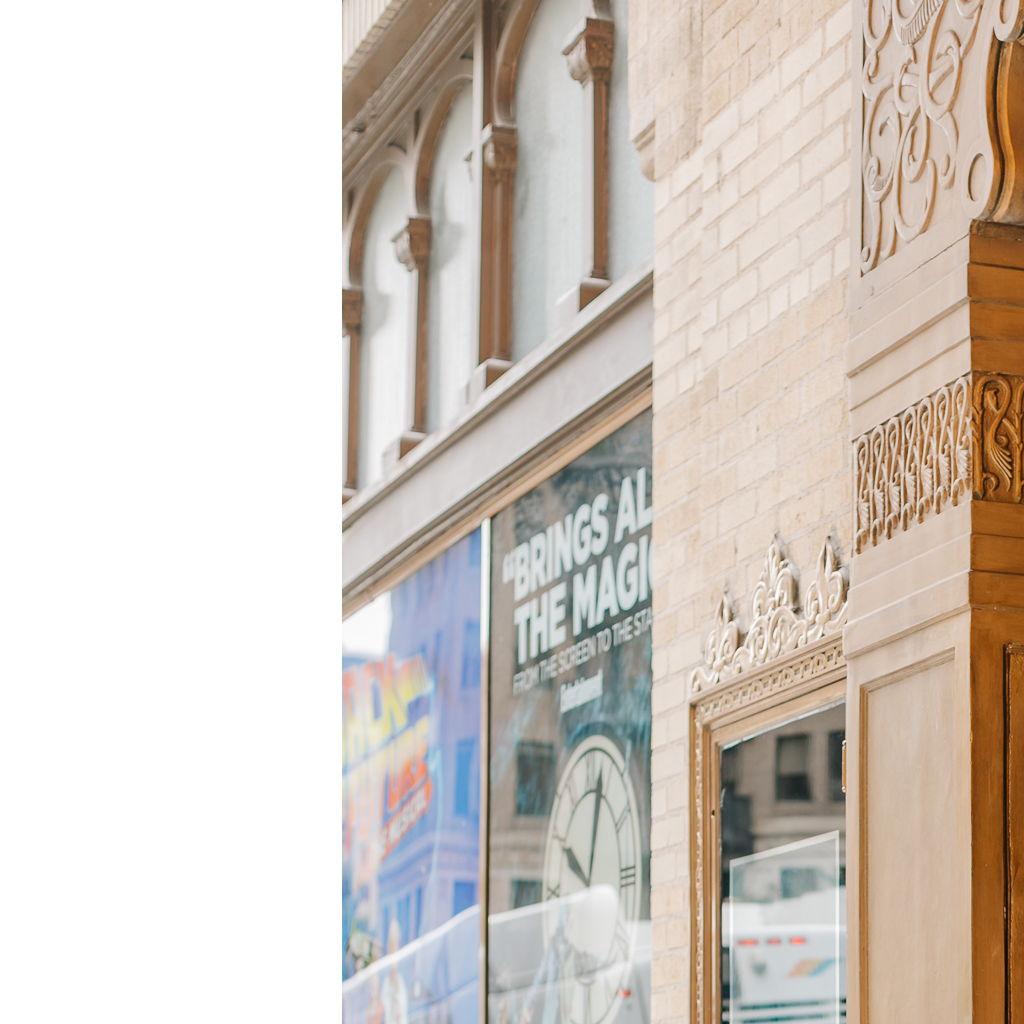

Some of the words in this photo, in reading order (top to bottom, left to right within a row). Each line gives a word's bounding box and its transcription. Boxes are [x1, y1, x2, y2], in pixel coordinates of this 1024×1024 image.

[514, 582, 566, 665] THE
[572, 535, 652, 636] MAGI
[596, 628, 612, 653] TO
[612, 616, 633, 647] THE
